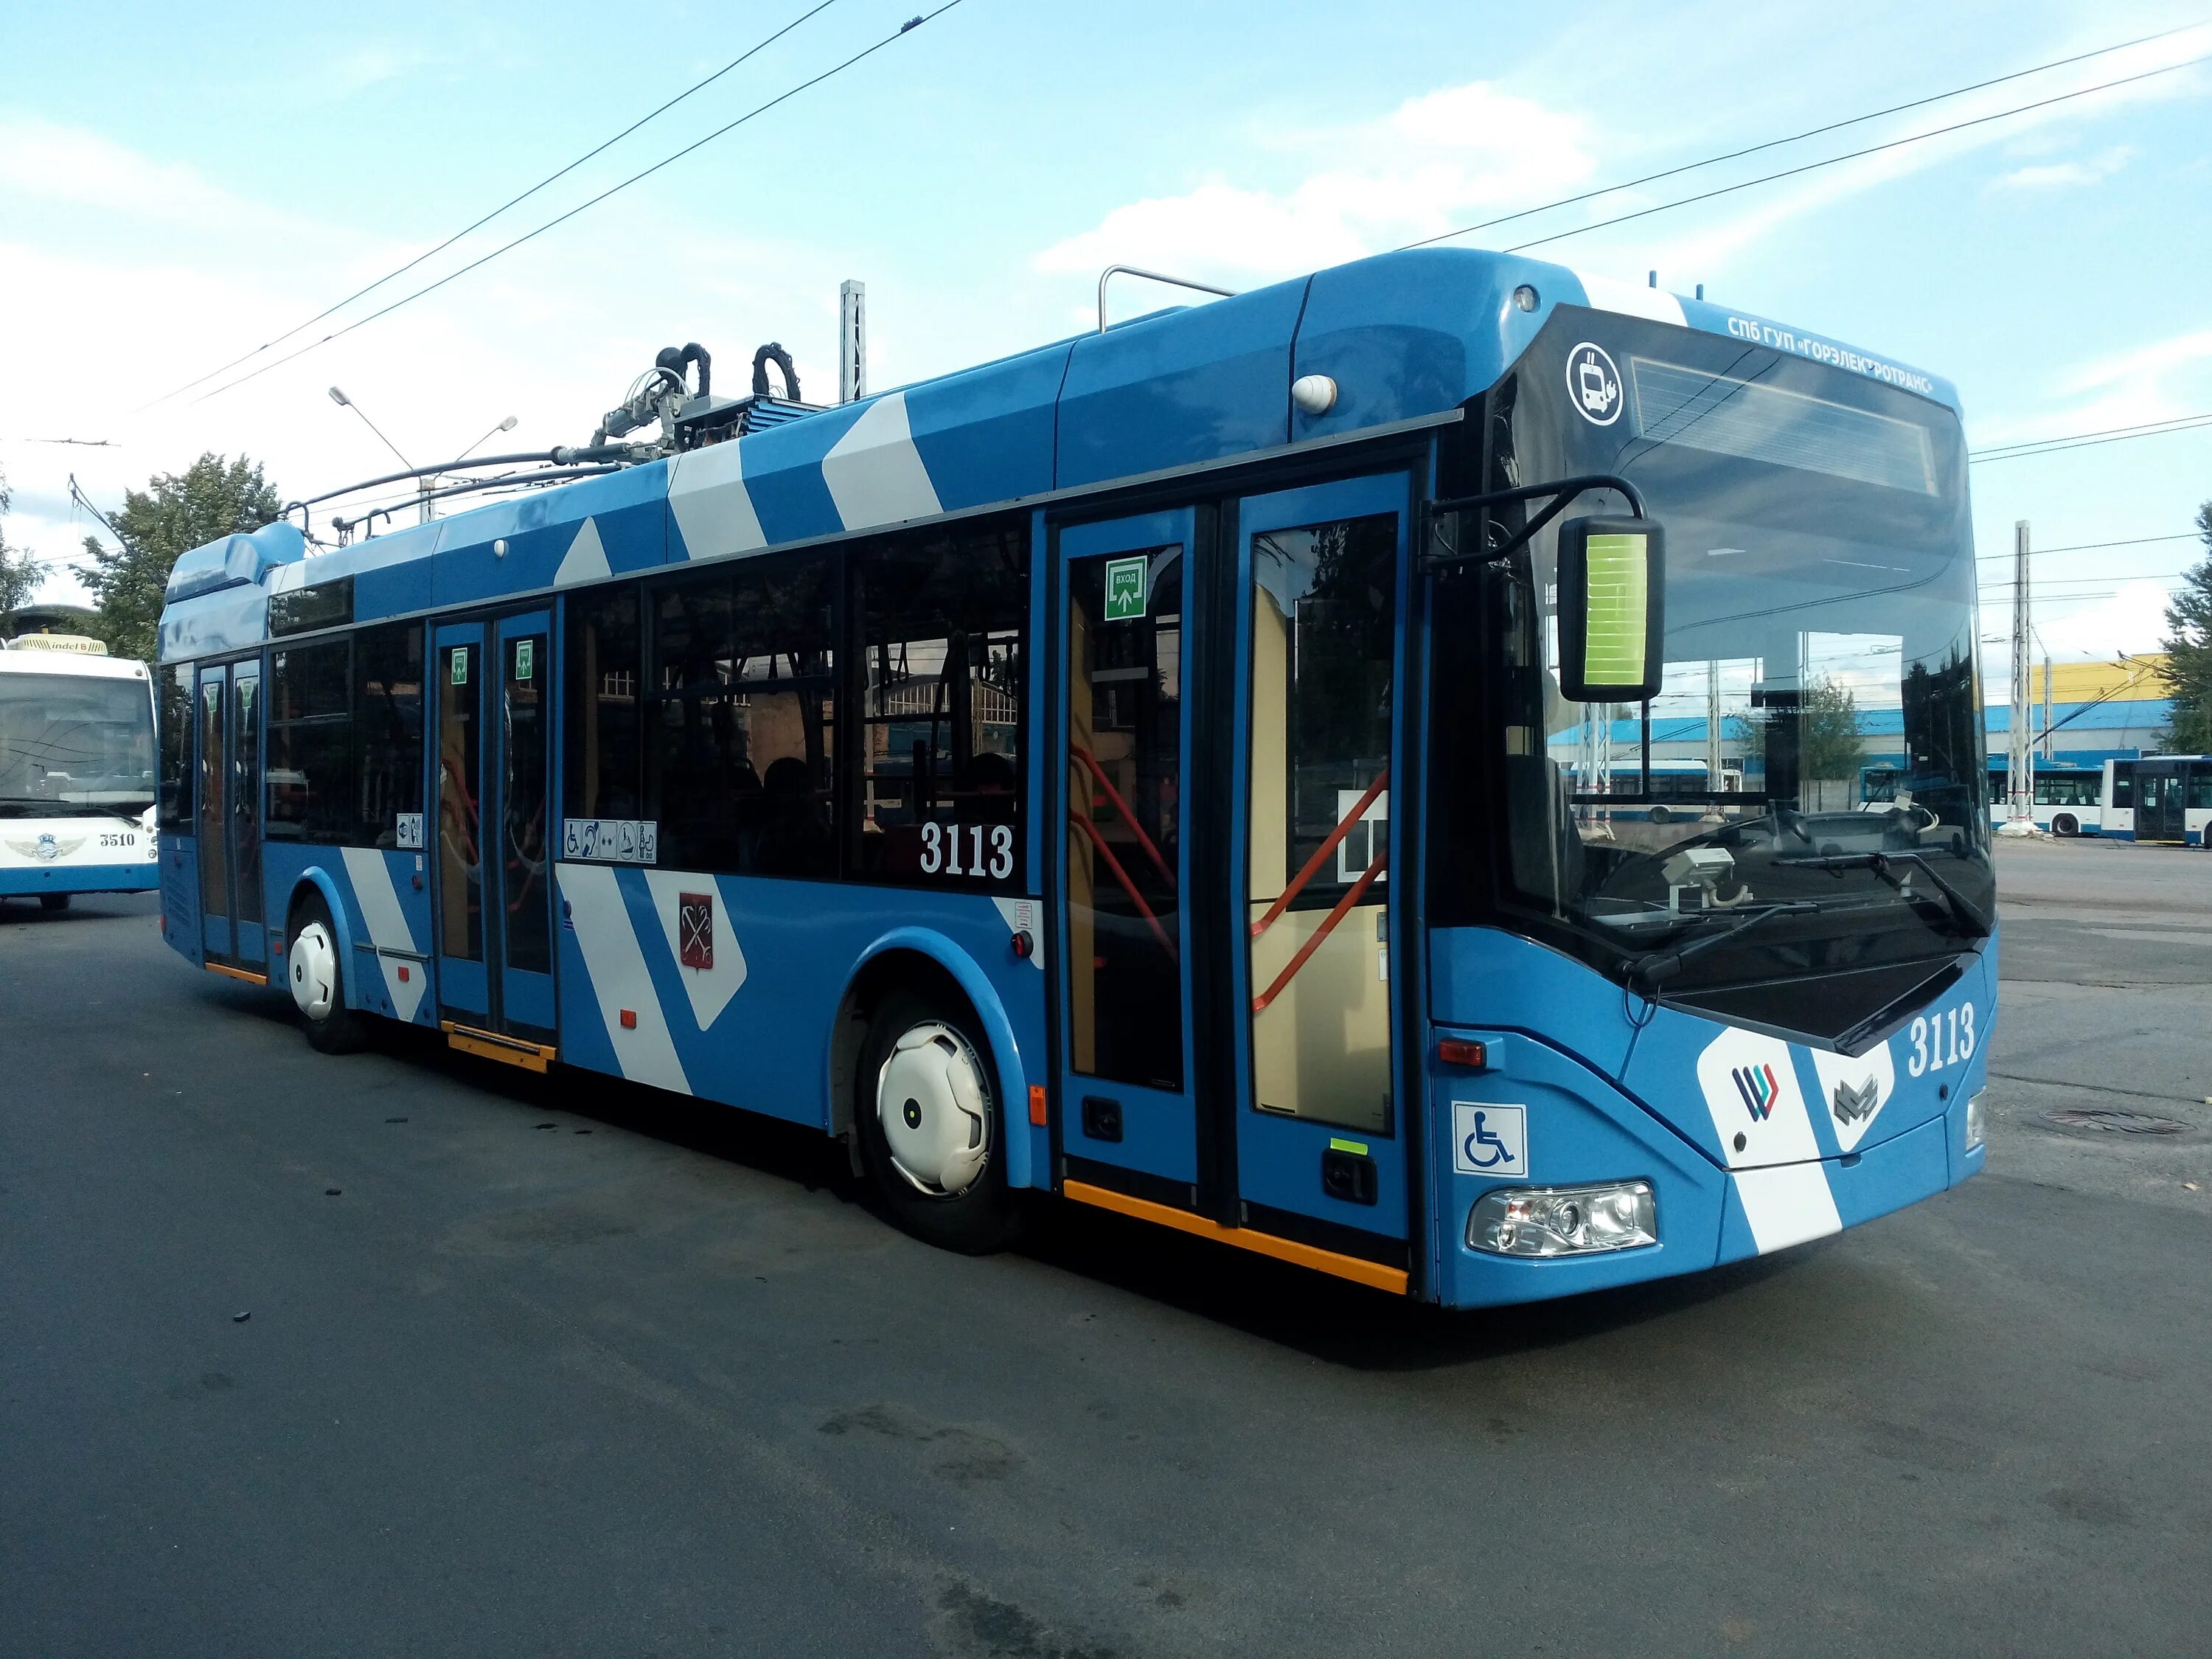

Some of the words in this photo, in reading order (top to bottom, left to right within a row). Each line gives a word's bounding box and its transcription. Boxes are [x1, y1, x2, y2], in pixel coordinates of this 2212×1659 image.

[1728, 317, 1760, 341] СПб
[1764, 327, 1795, 352] ГУП
[1116, 573, 1136, 585] ВХОД
[52, 641, 78, 650] indel
[100, 833, 135, 846] 3510
[920, 821, 1013, 879] 3113
[1908, 1001, 1975, 1077] 3113
